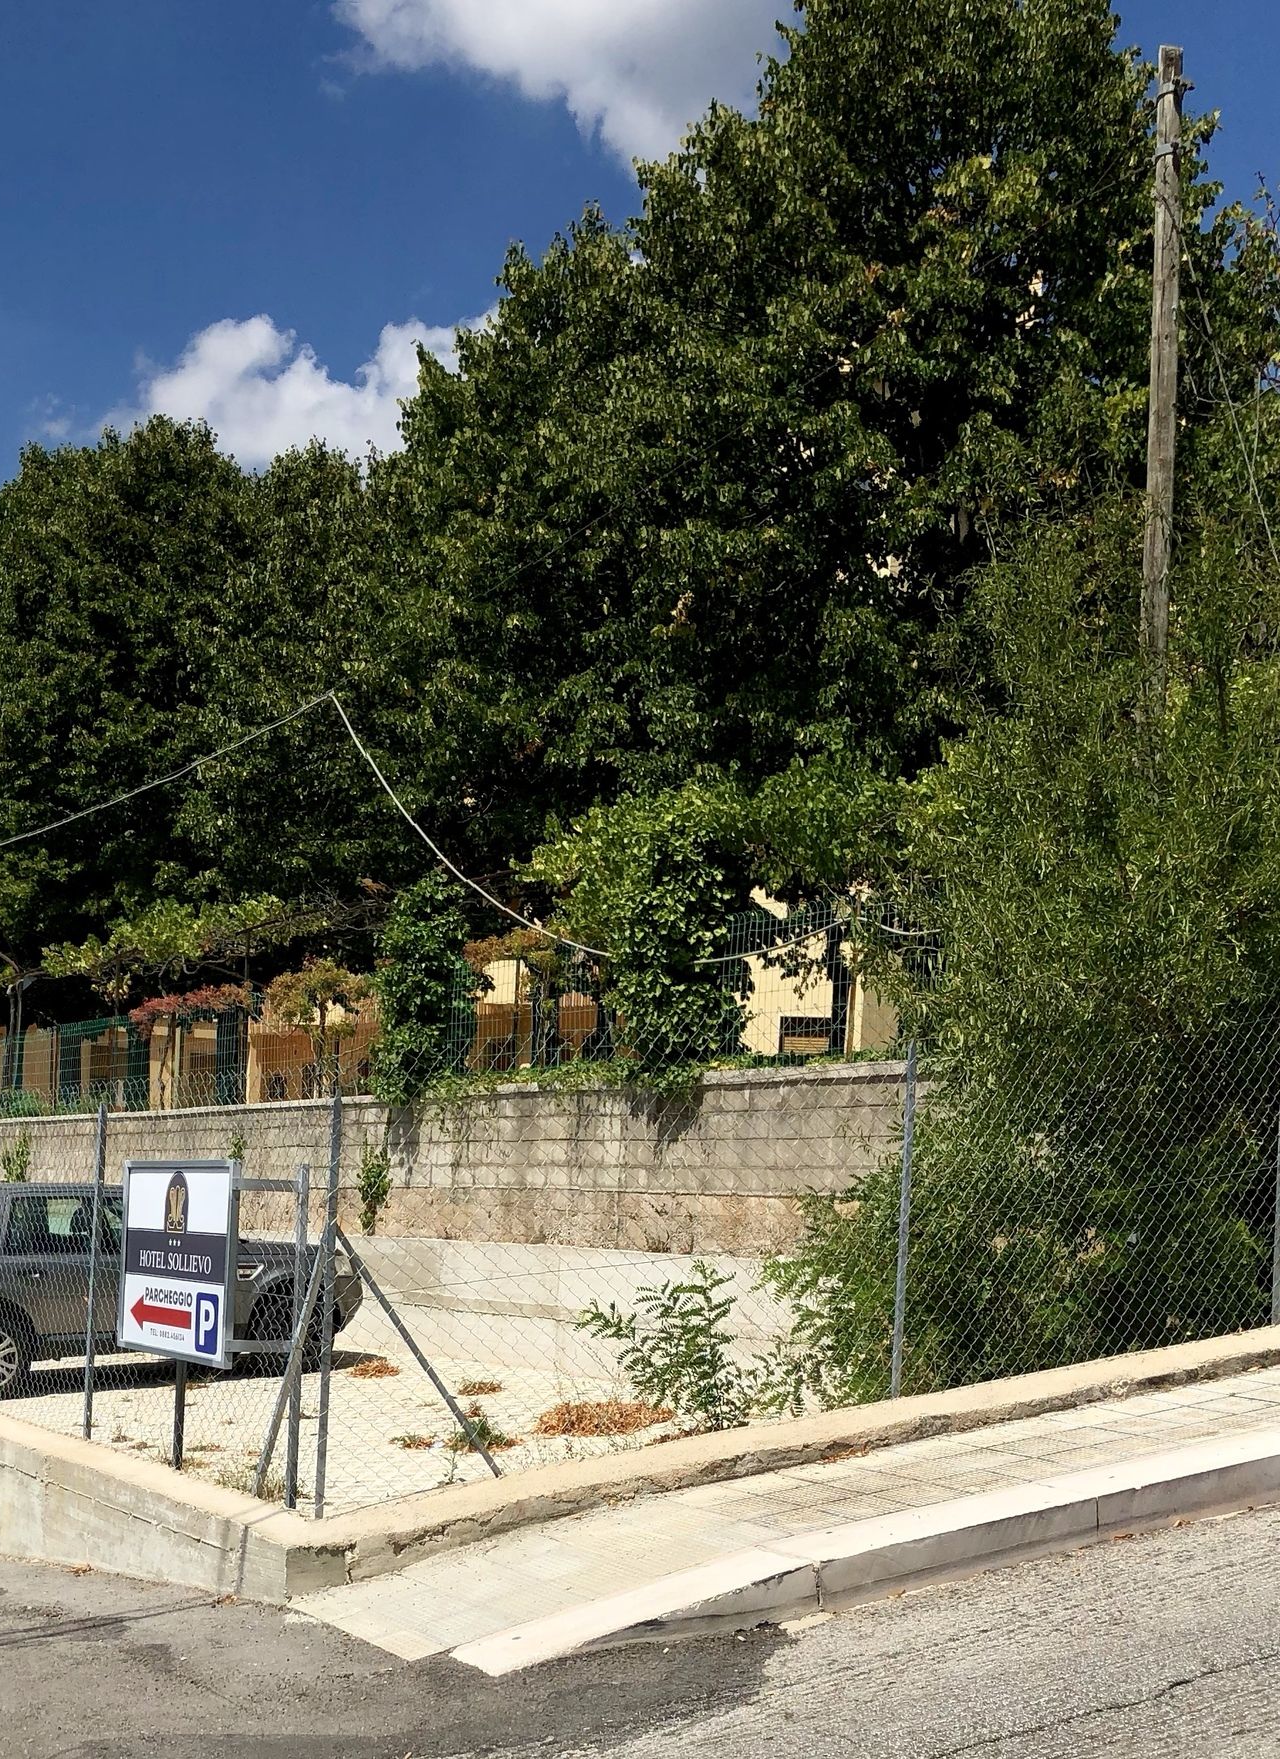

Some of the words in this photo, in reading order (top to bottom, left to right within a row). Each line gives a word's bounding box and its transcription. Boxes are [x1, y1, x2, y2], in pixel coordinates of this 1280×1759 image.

[139, 1249, 166, 1269] HOTEL
[167, 1252, 212, 1275] SOLLIEVO
[144, 1286, 193, 1308] PARCHEGGIO
[198, 1299, 215, 1346] P
